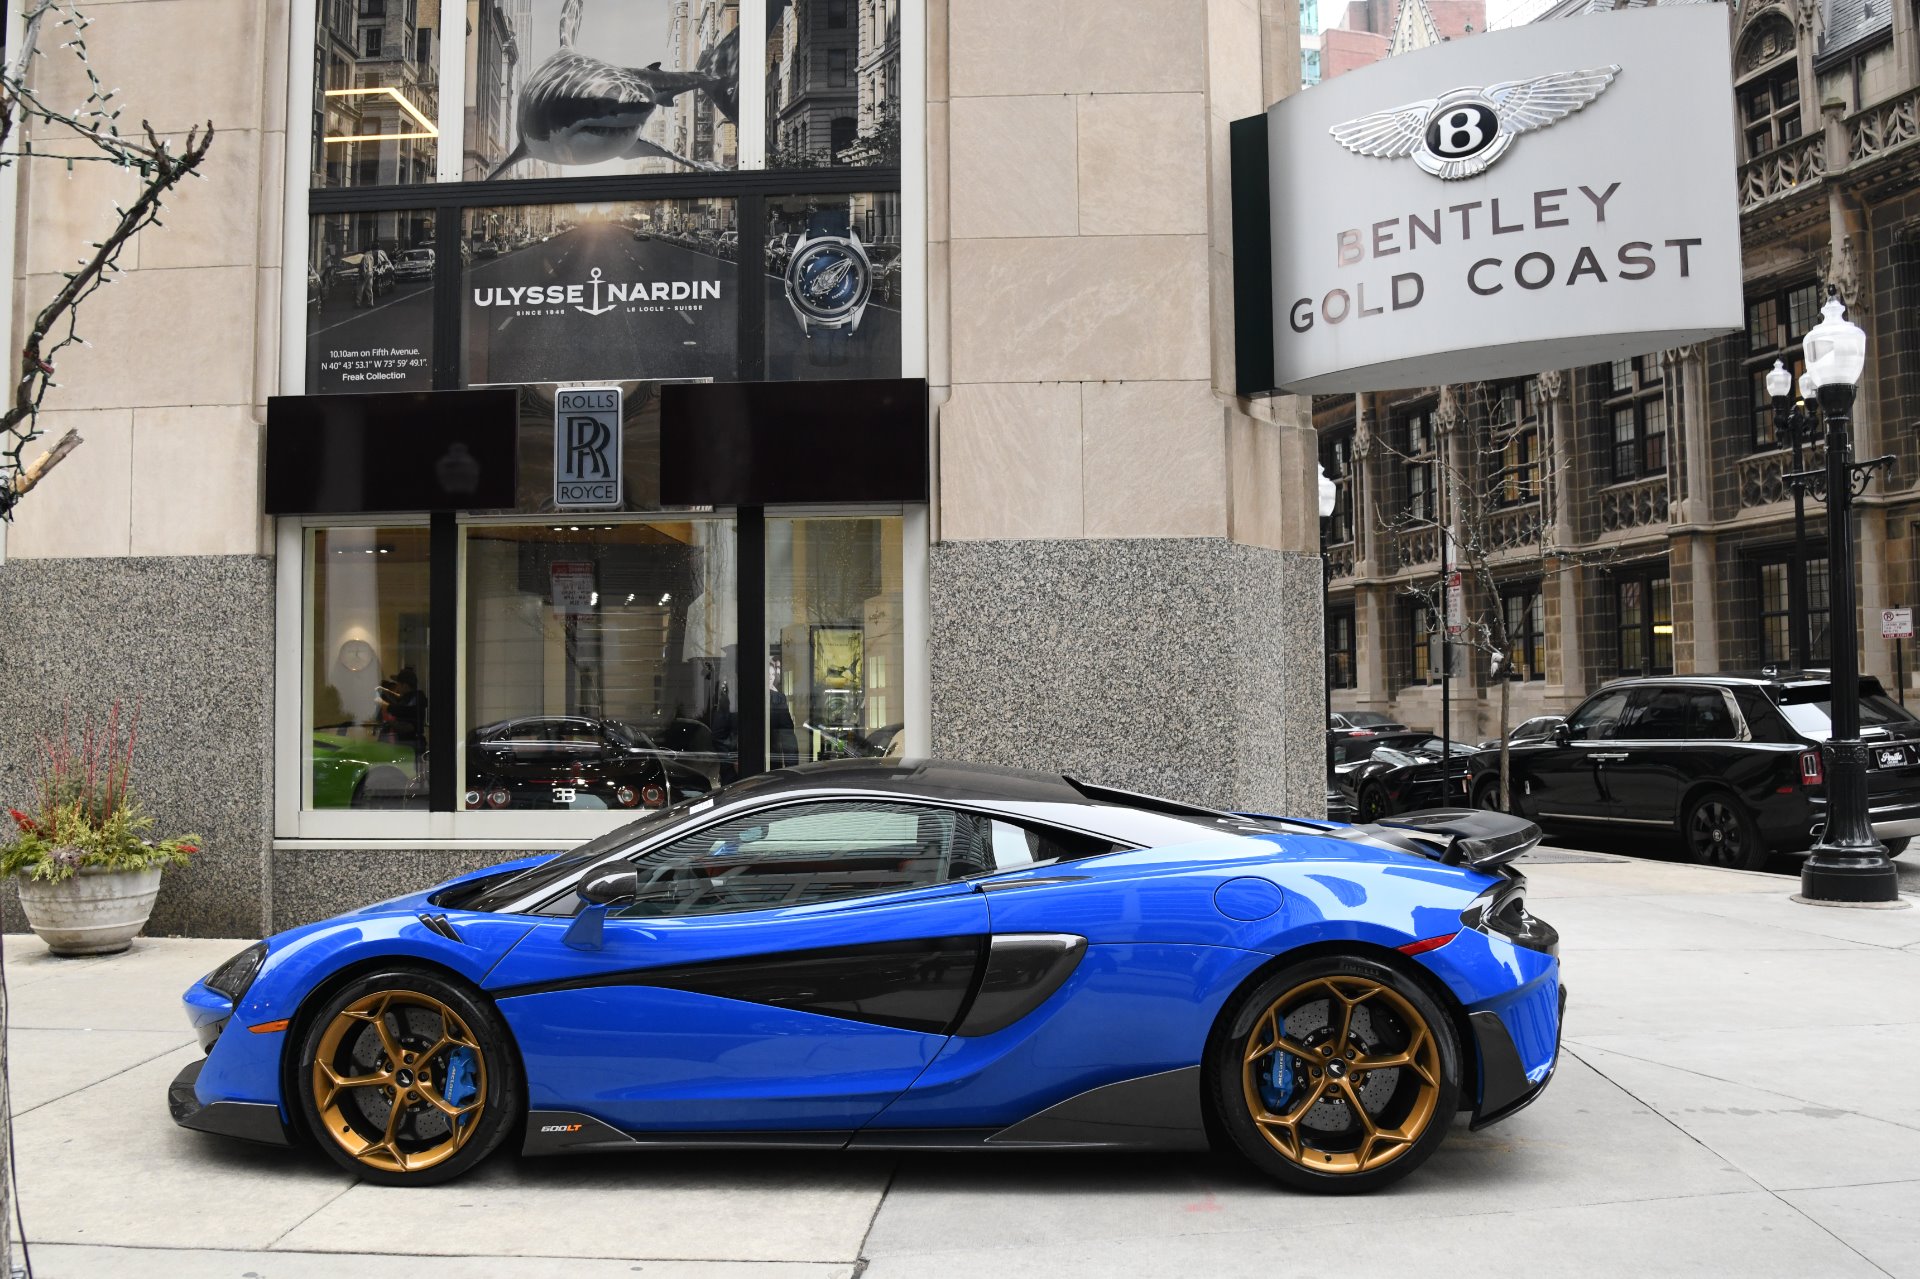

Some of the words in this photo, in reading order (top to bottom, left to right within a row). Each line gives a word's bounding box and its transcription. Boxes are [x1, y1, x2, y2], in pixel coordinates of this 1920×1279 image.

[1437, 107, 1483, 153] B
[1336, 182, 1622, 268] BENTLEY
[1289, 271, 1425, 334] GOLD
[1466, 237, 1702, 297] COAST
[474, 284, 584, 307] ULYSSE
[607, 280, 721, 302] NARDIN
[329, 350, 359, 358] 10.10am
[372, 348, 389, 356] Fifth
[390, 348, 420, 356] Avenue.
[373, 360, 382, 368] W
[342, 373, 365, 381] Freak
[366, 372, 406, 380] Collection
[562, 394, 614, 409] ROLLS
[561, 485, 613, 499] ROYCE
[540, 1124, 582, 1133] 600LT
